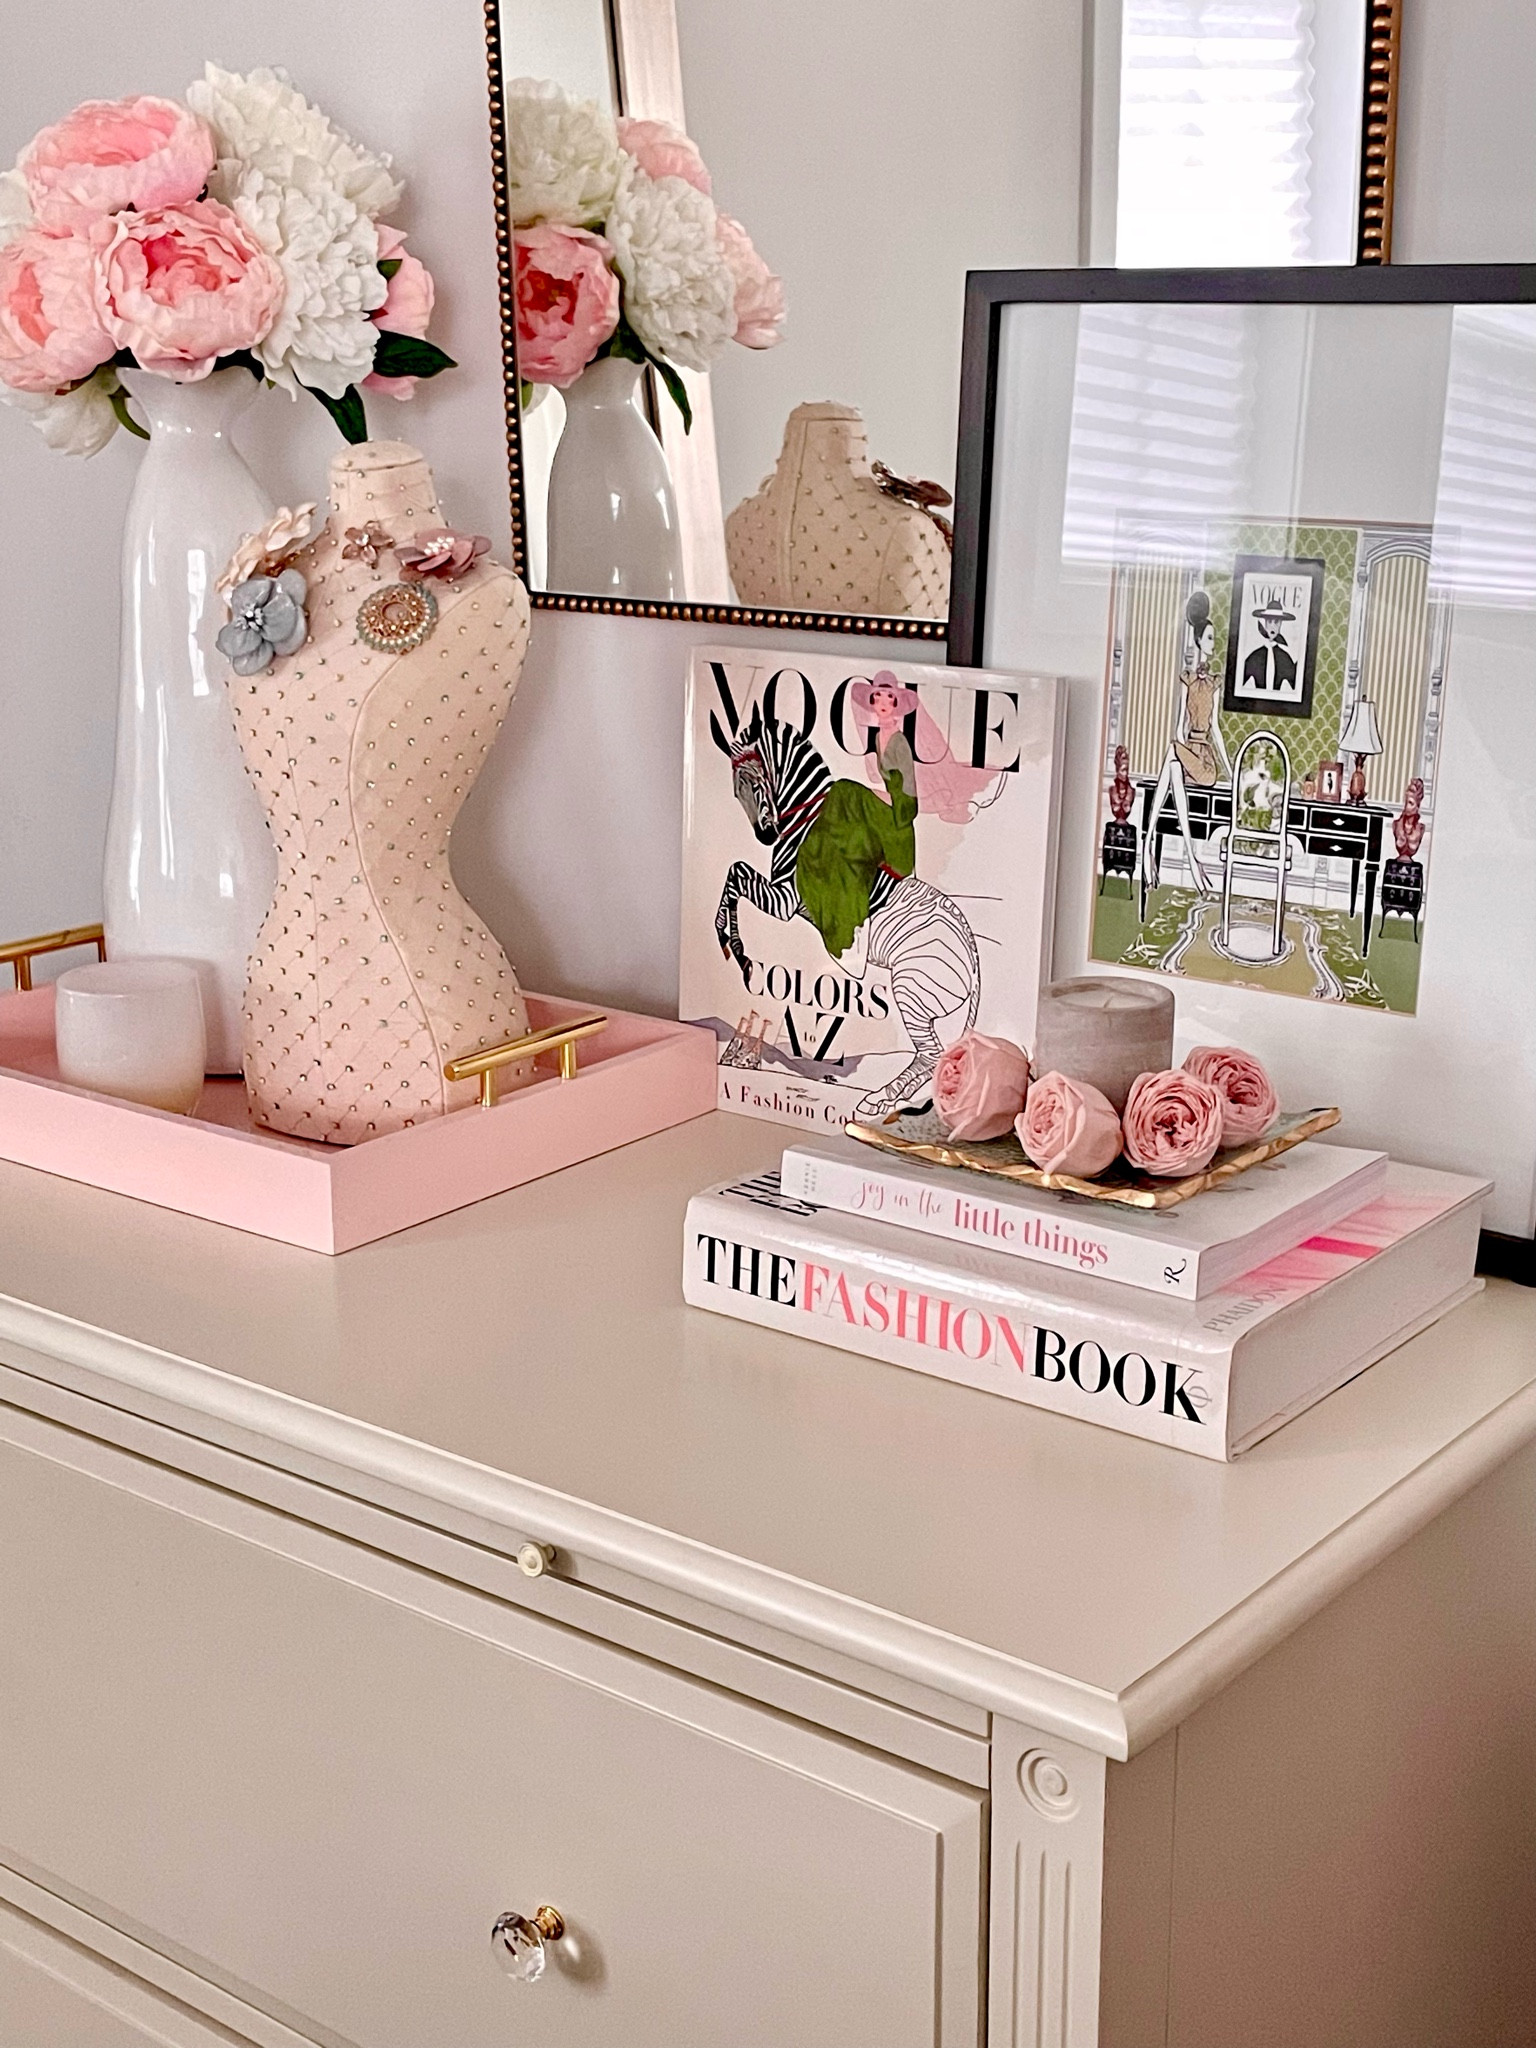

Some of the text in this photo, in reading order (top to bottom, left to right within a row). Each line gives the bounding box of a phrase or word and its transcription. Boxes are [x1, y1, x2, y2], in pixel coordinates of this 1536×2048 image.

[1252, 583, 1303, 608] VOGUE
[703, 661, 1020, 773] VOGUE
[743, 960, 889, 1021] COLORS
[774, 1005, 845, 1067] A to Z
[720, 1082, 732, 1099] A
[741, 1086, 815, 1119] Fashion
[894, 1195, 908, 1207] in
[919, 1189, 941, 1217] the
[954, 1198, 1015, 1241] little
[1023, 1218, 1109, 1270] things
[1203, 1286, 1288, 1333] PHAIDON
